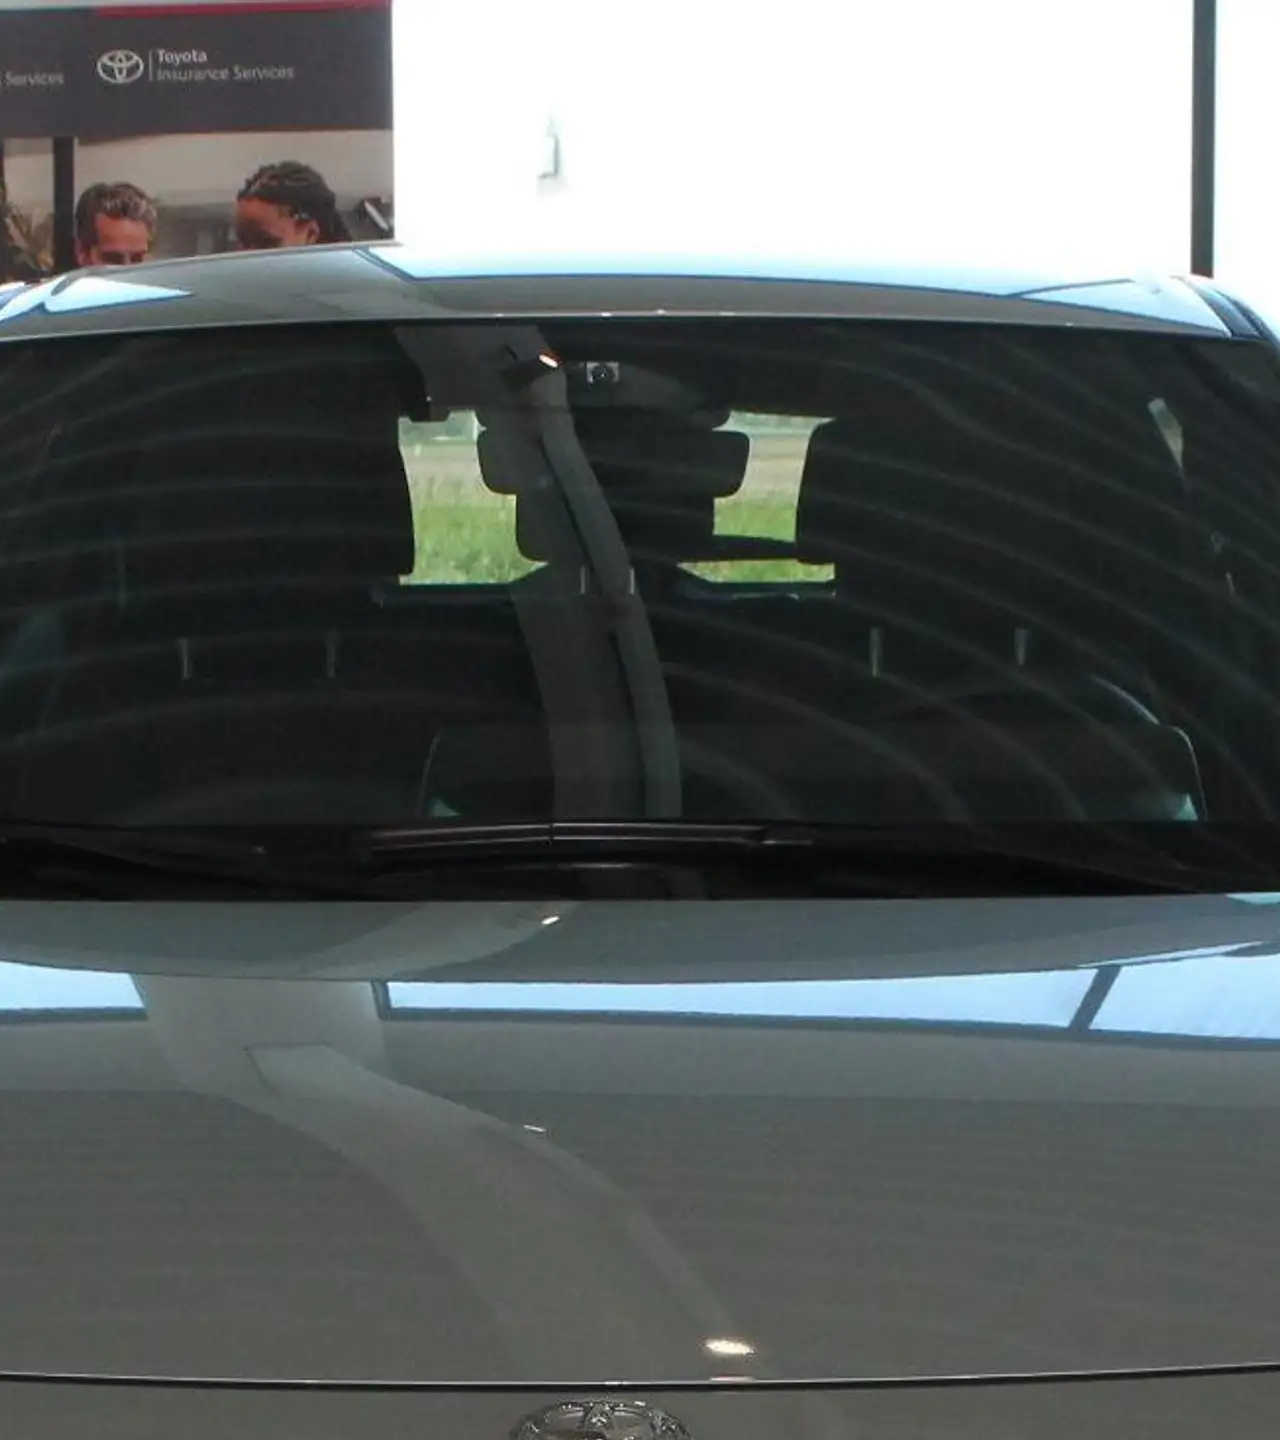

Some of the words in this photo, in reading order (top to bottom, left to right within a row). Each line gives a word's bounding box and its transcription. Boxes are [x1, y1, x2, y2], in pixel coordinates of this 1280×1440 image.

[156, 49, 208, 66] Toyota
[5, 70, 65, 87] Services
[157, 66, 229, 81] Insurance
[232, 64, 295, 80] Services
